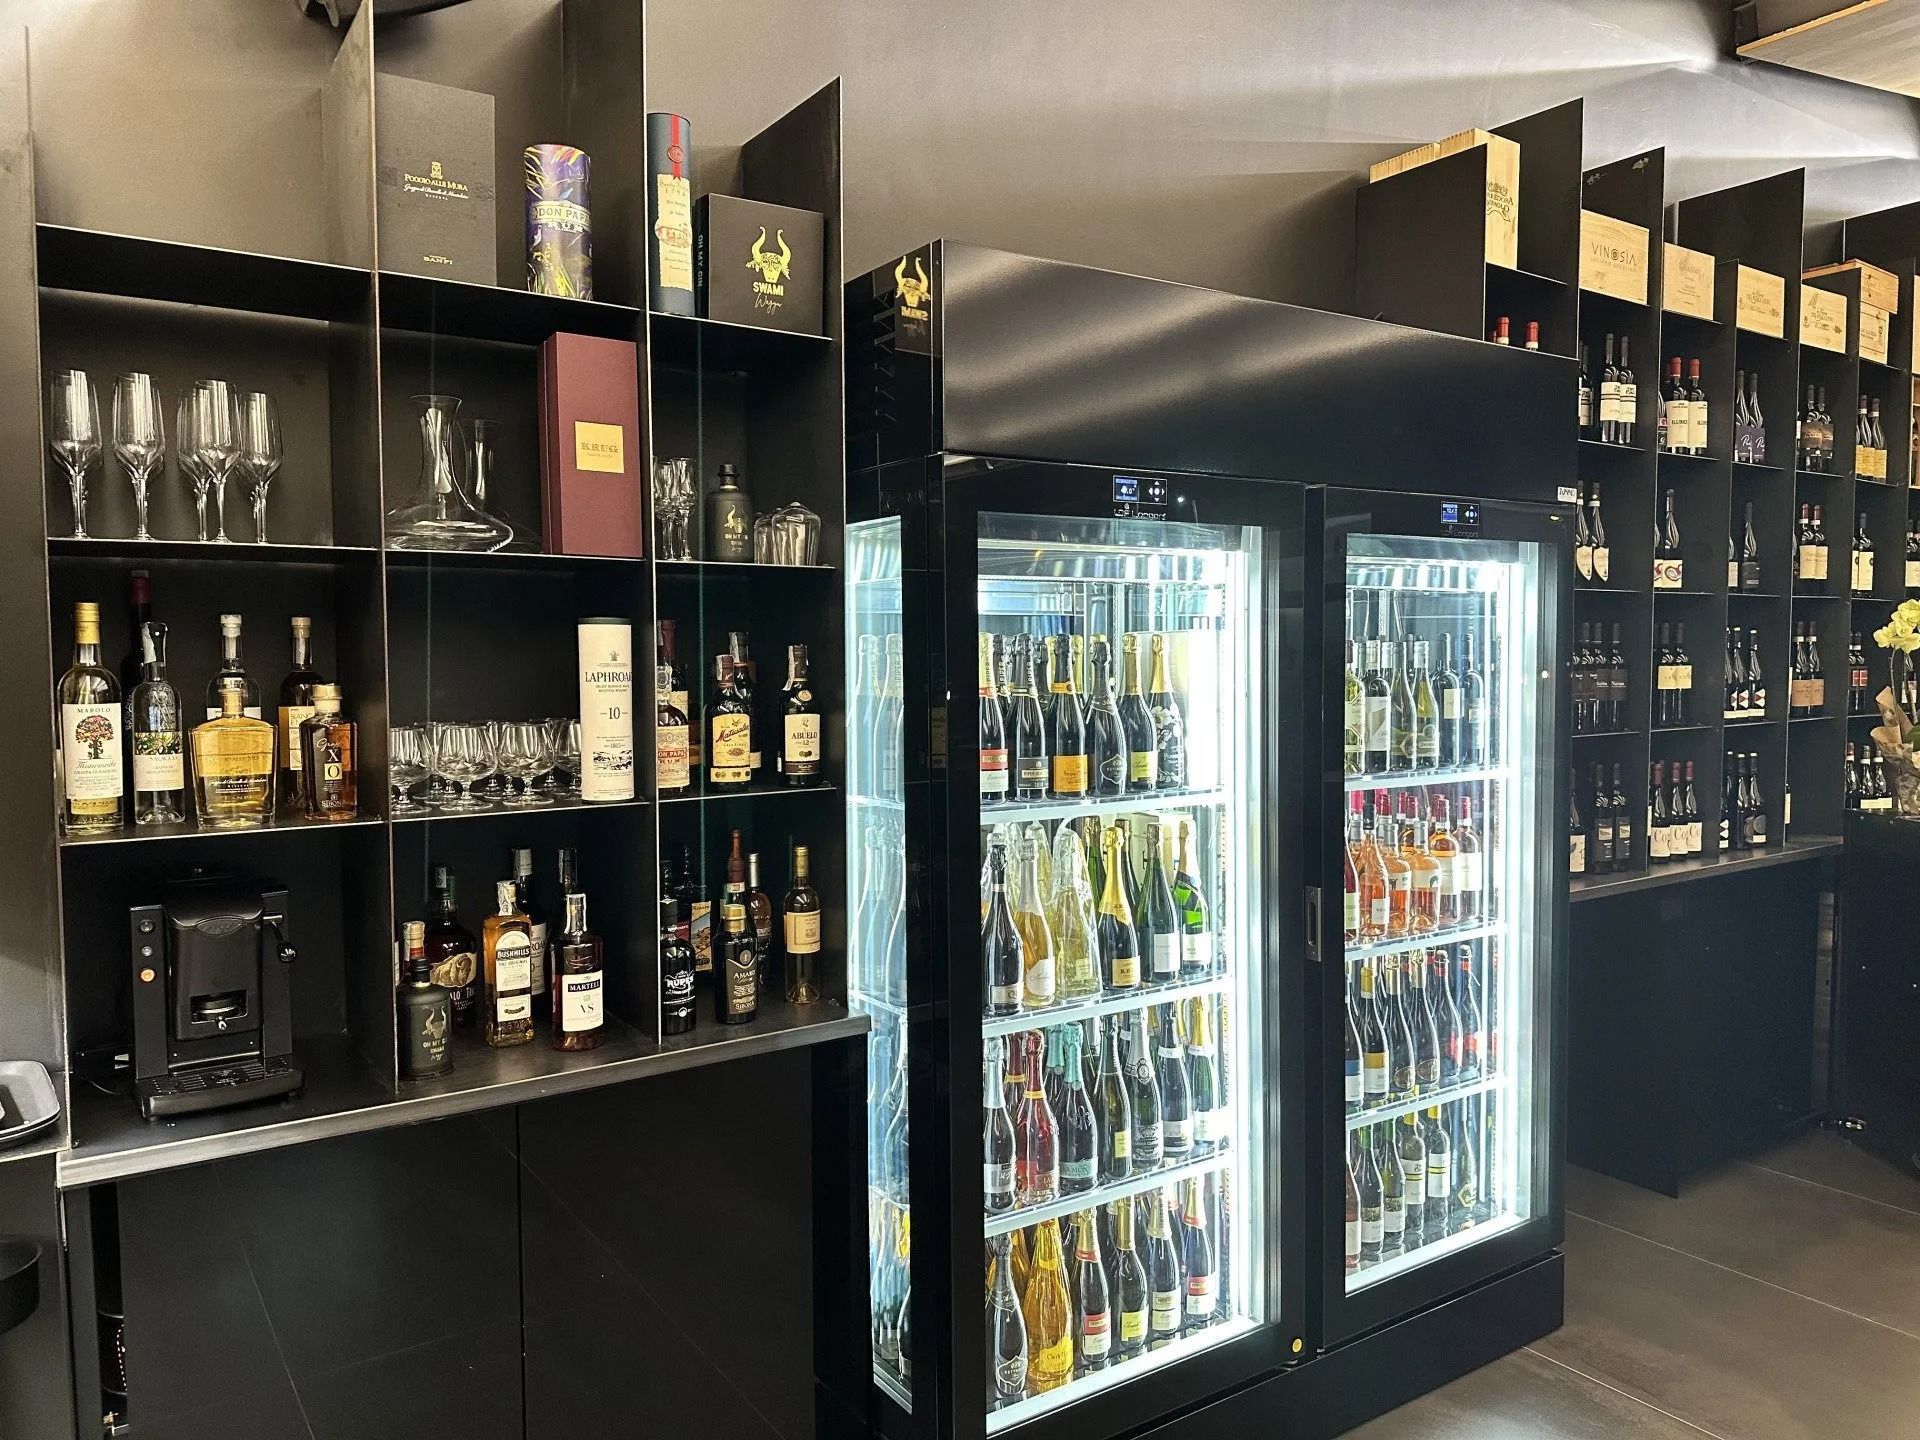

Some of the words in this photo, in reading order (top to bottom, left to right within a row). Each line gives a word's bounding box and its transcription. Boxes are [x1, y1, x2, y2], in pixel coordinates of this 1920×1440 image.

[538, 207, 562, 217] DON
[752, 281, 784, 296] SWAMI
[581, 442, 619, 453] KRUG
[608, 706, 621, 720] 10
[792, 731, 818, 739] ABUELO
[327, 748, 339, 762] X
[327, 764, 340, 779] O
[497, 948, 530, 958] BUSHMILLS
[734, 970, 756, 980] AMARO
[569, 981, 600, 993] MARTELL
